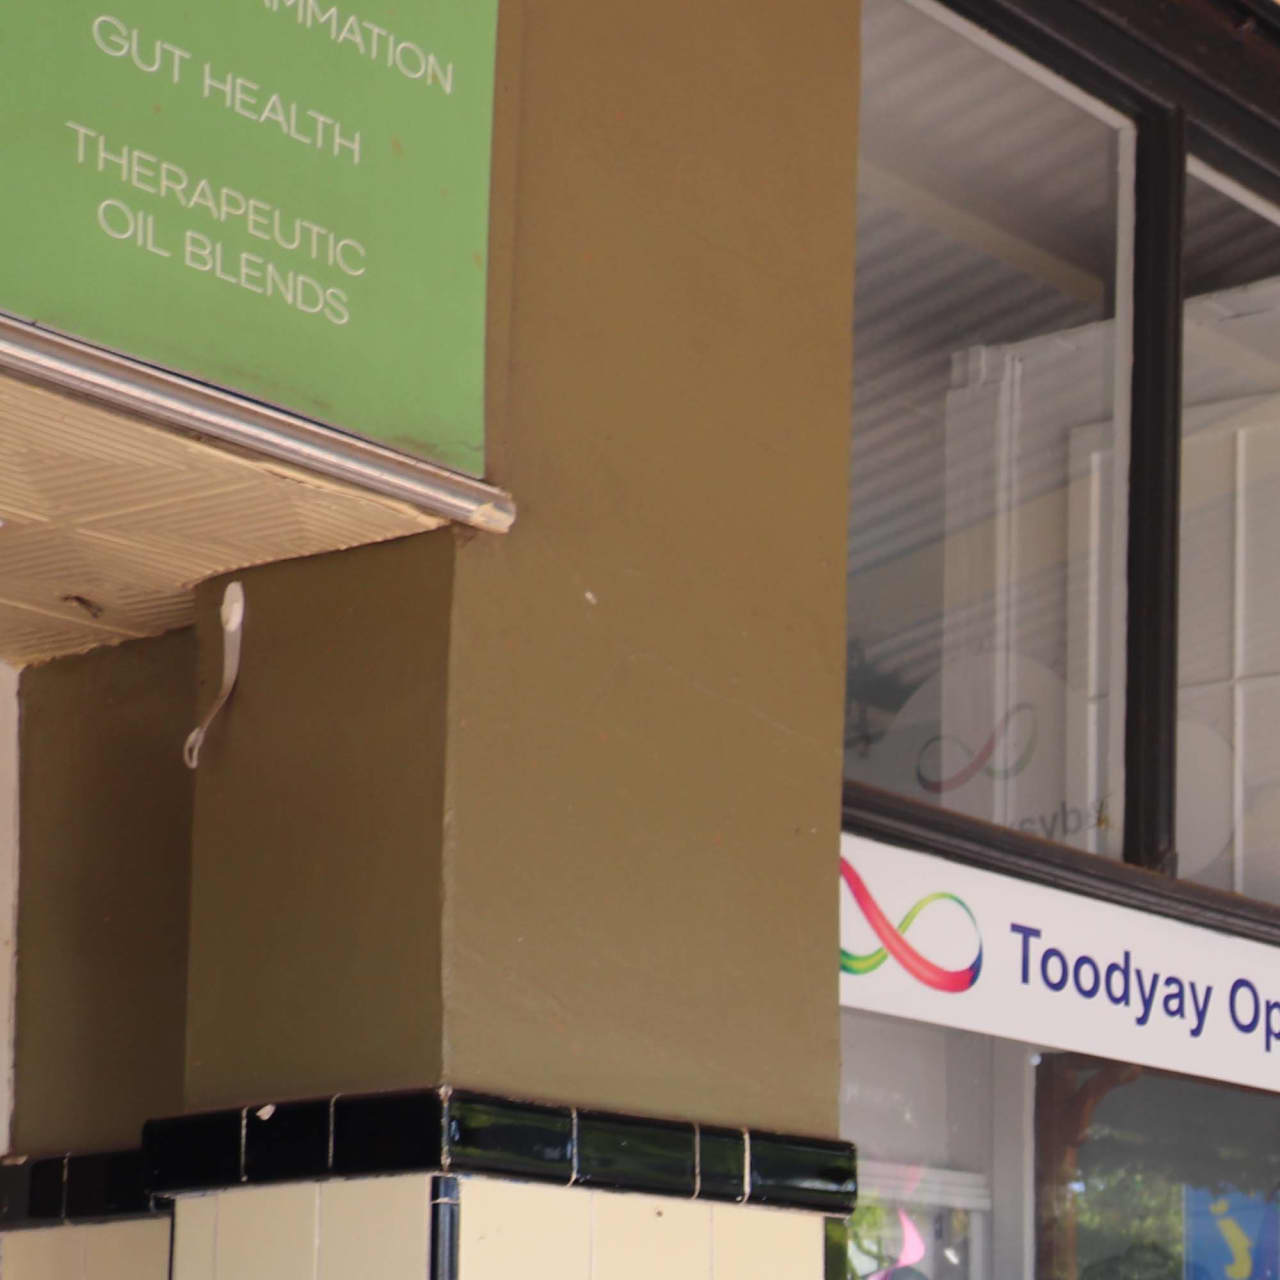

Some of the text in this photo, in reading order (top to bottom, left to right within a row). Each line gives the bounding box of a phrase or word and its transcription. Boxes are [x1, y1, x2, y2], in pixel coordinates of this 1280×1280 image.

[93, 15, 361, 165] GUT HEALTH
[263, 0, 453, 95] MATION
[65, 120, 366, 276] THERAPEUTIC
[97, 199, 349, 325] OIL BLENDS
[1010, 923, 1213, 1037] Toodyay
